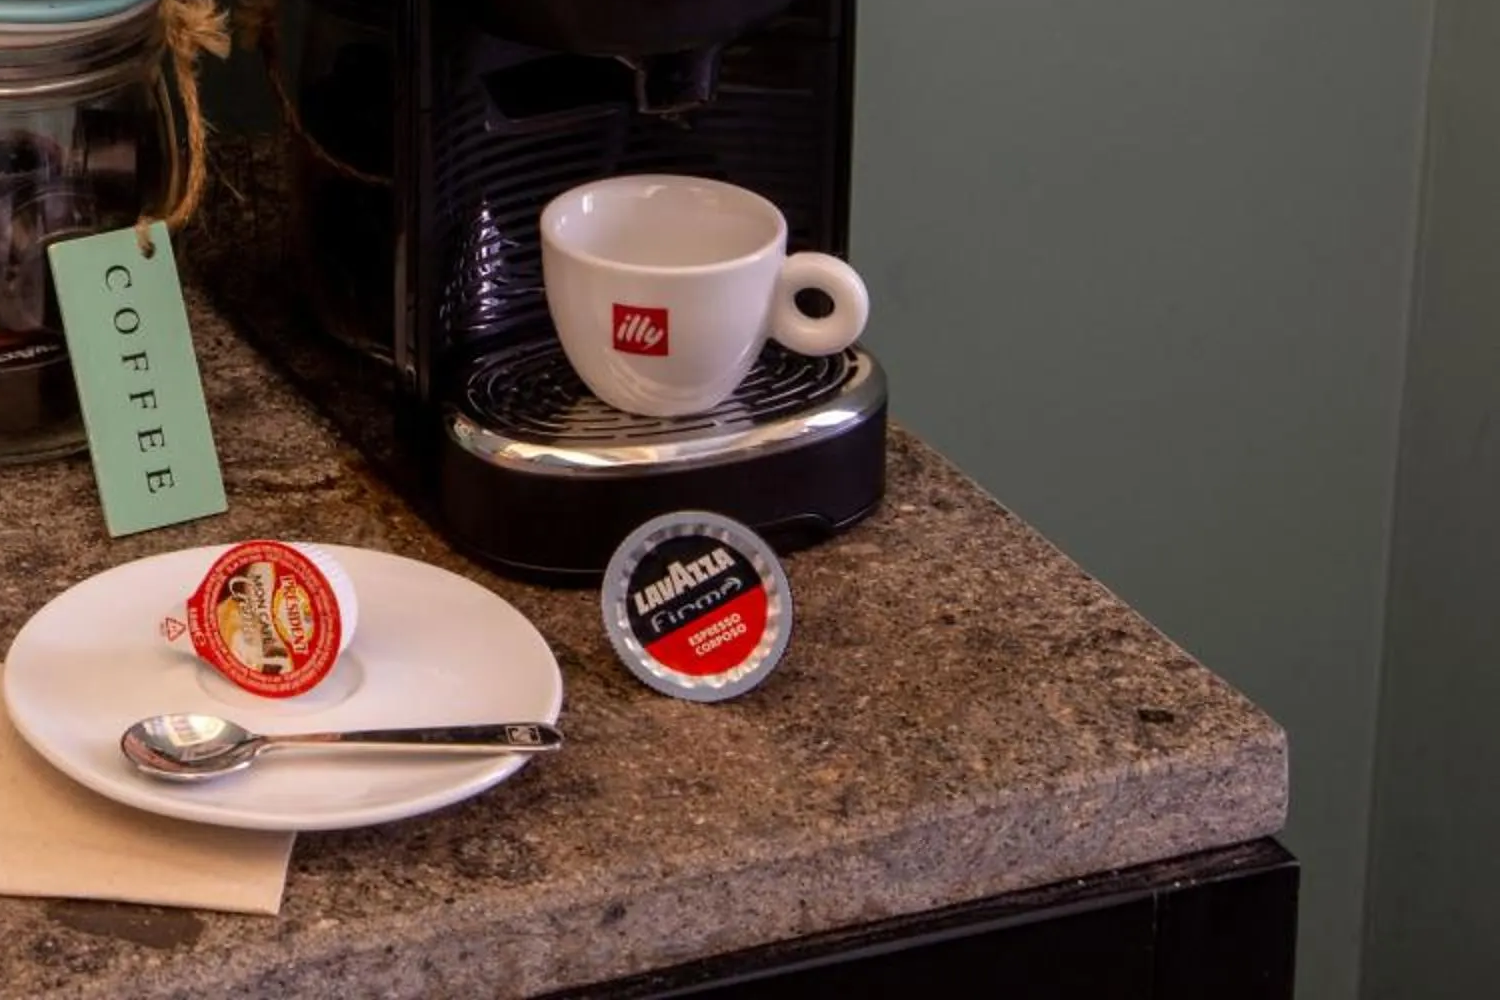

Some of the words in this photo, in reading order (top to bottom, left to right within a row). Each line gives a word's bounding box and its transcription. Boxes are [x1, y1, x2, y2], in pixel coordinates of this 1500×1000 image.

[616, 313, 664, 351] illy
[105, 265, 175, 494] COFFEE
[633, 547, 736, 617] LAVAZZA
[688, 612, 741, 648] ESPRESSO
[695, 623, 747, 657] CORPOSO
